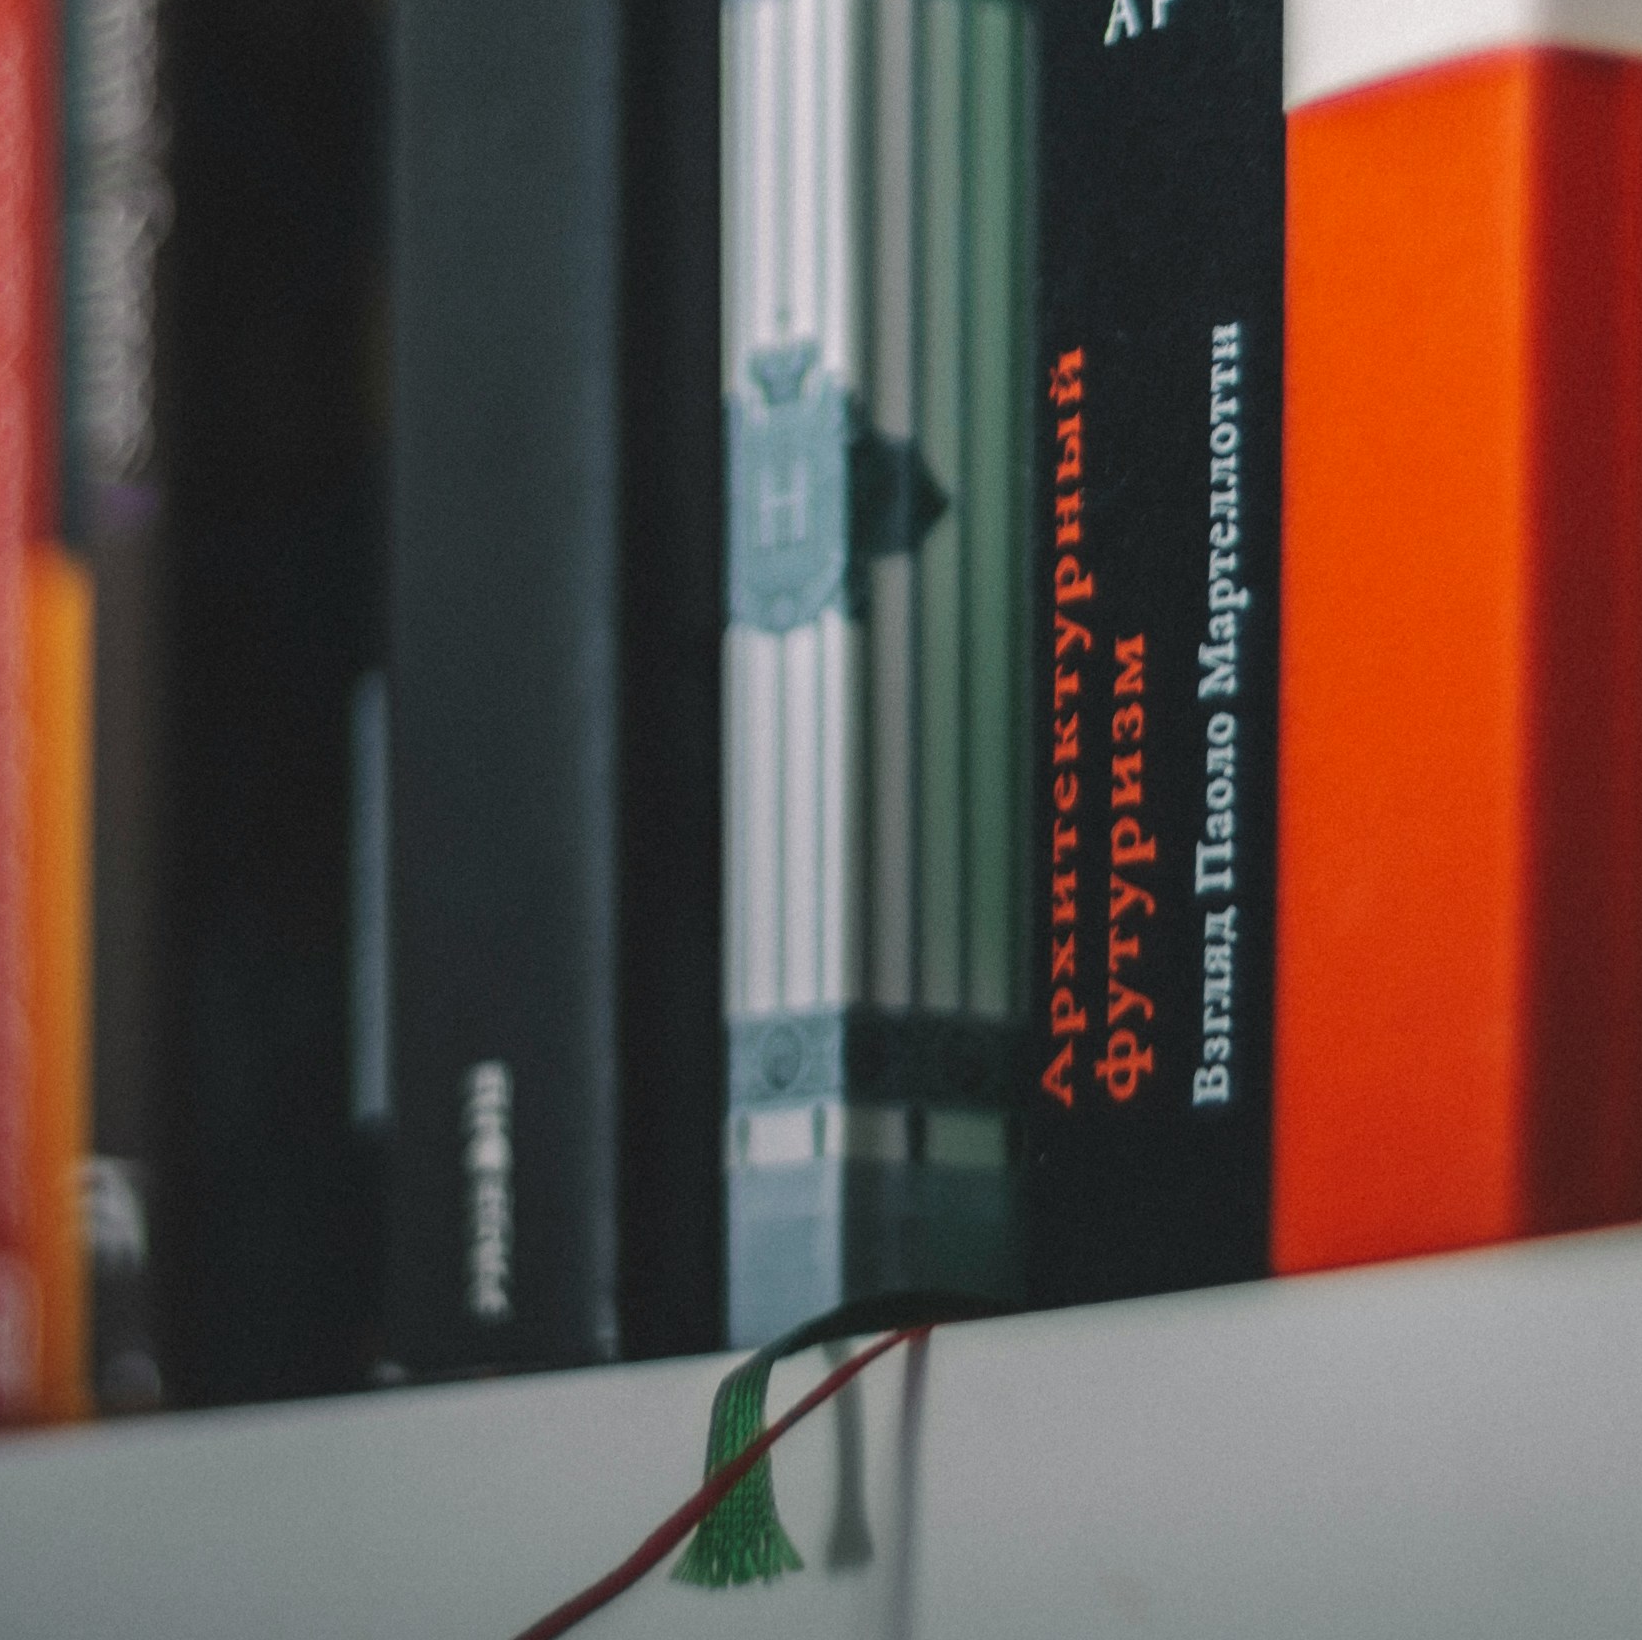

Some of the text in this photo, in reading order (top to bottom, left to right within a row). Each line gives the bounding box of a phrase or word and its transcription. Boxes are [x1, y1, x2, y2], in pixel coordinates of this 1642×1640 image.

[1041, 345, 1094, 1109] Архитектурный
[1192, 321, 1251, 1106] Взгляд Паоло Мартеллотти
